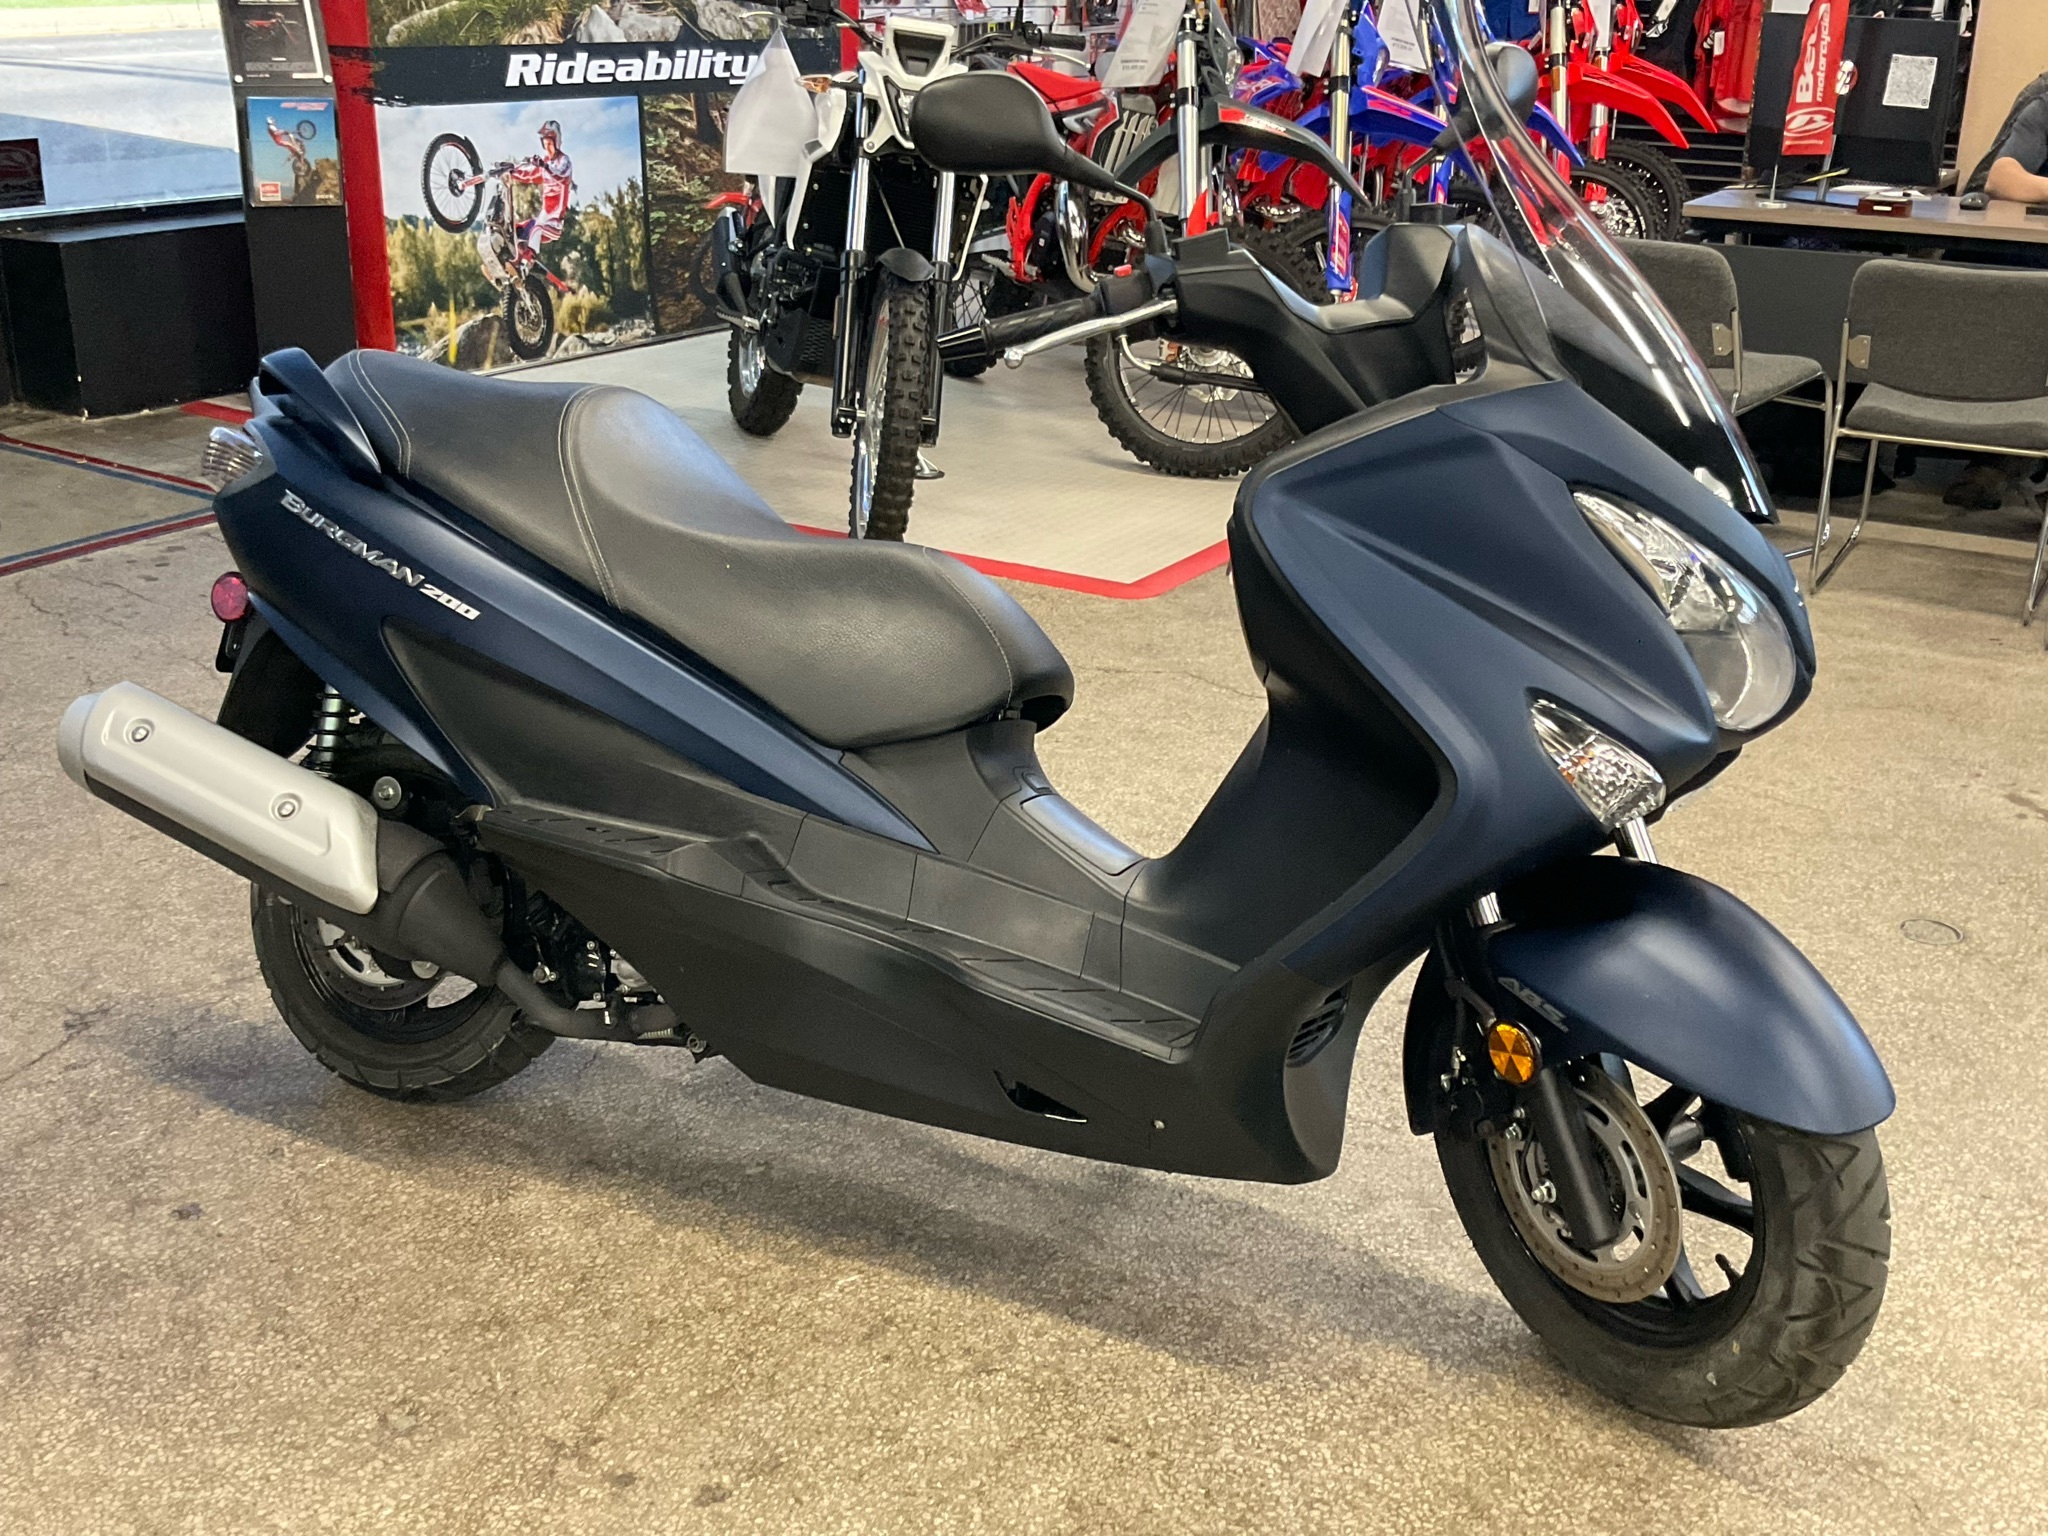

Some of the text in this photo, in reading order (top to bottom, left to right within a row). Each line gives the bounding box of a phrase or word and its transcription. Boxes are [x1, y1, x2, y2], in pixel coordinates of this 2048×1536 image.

[505, 49, 758, 87] Rideability
[281, 488, 481, 621] BURGMAN 200
[1498, 977, 1568, 1032] ABS
